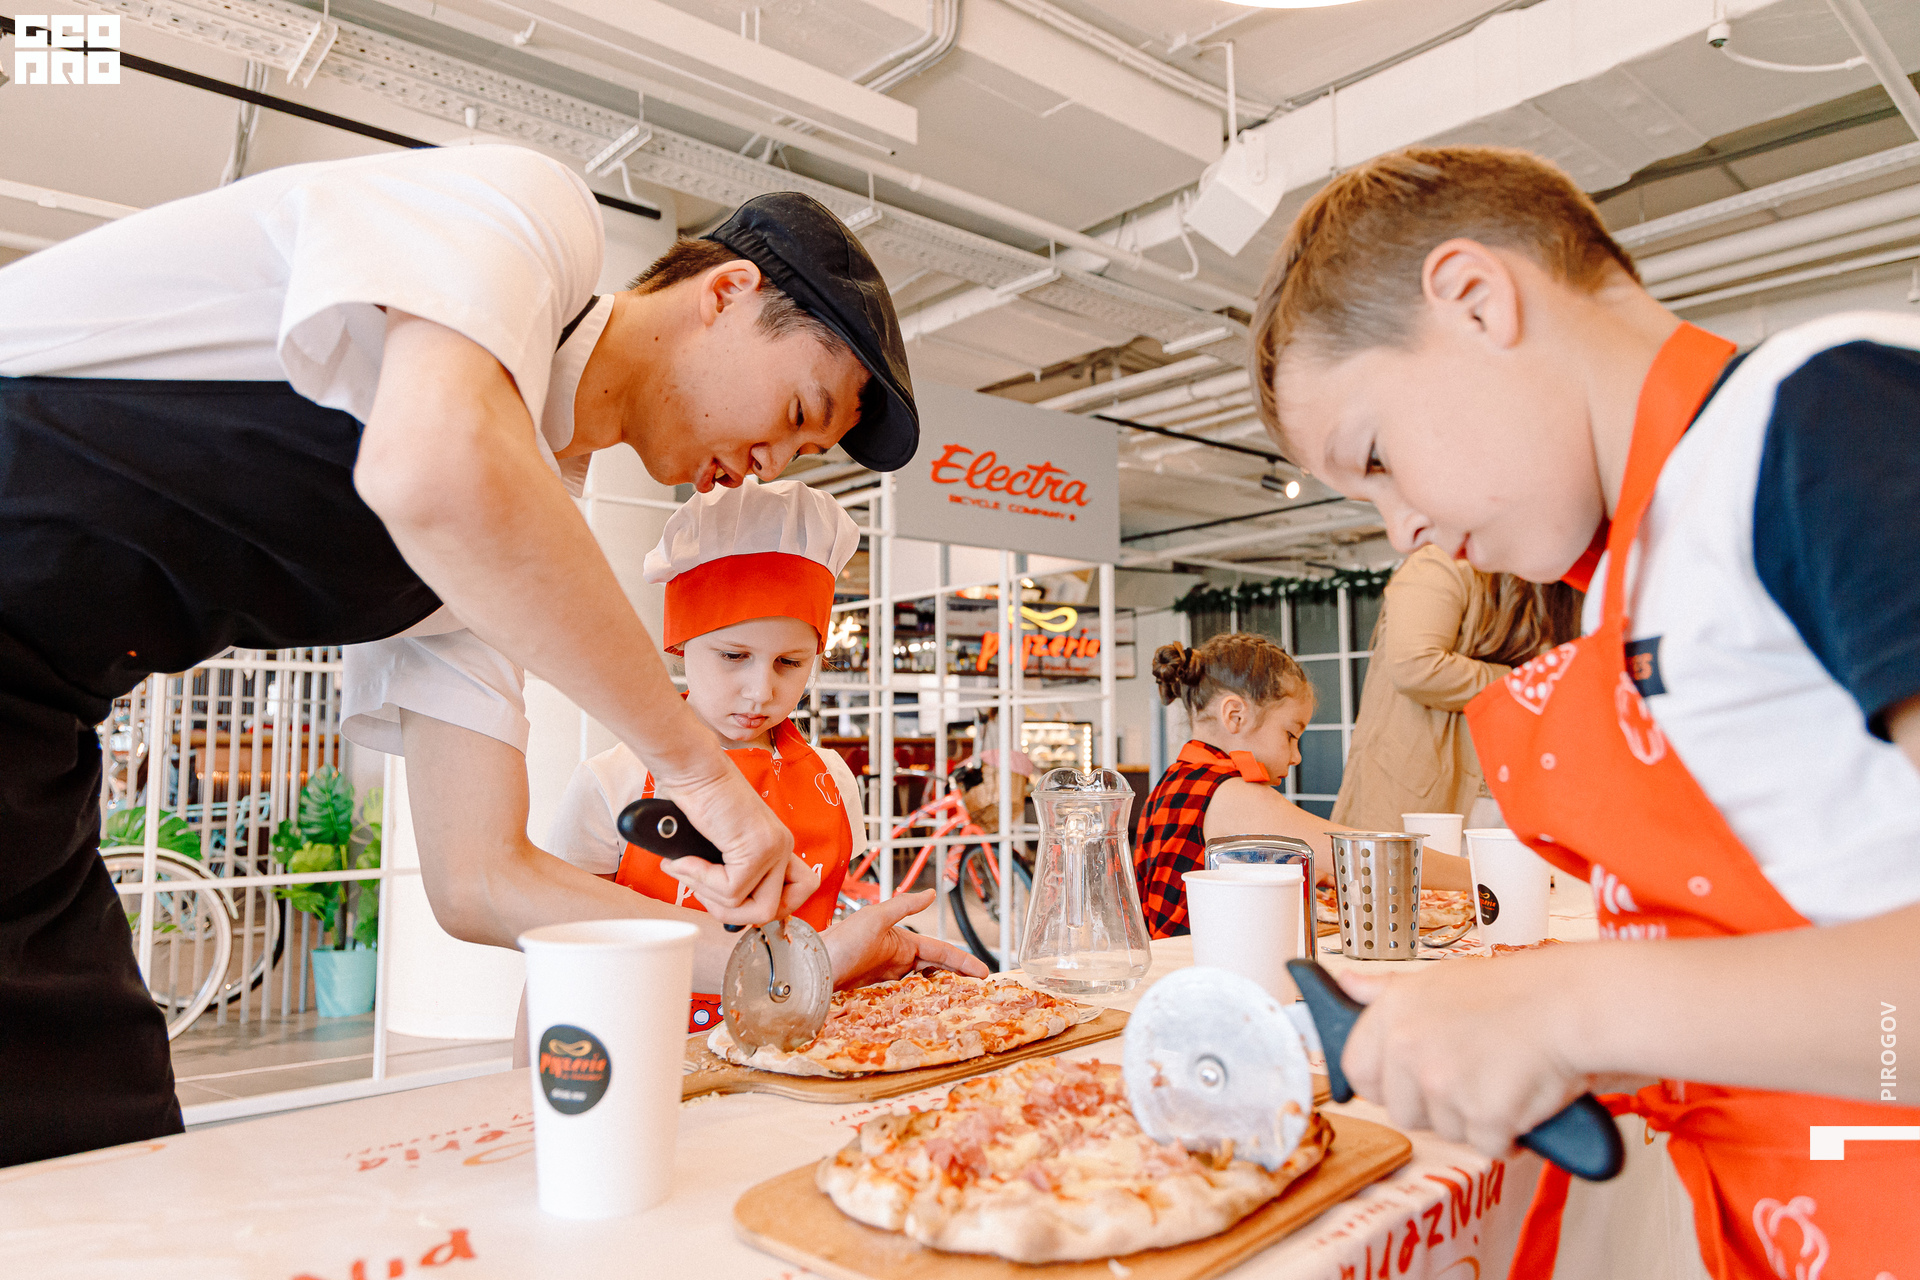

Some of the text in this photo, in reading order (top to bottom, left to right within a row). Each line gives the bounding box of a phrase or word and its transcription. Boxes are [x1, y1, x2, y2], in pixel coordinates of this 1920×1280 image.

[930, 444, 1092, 507] Electra
[948, 494, 1066, 520] BICYCLE COMPANY
